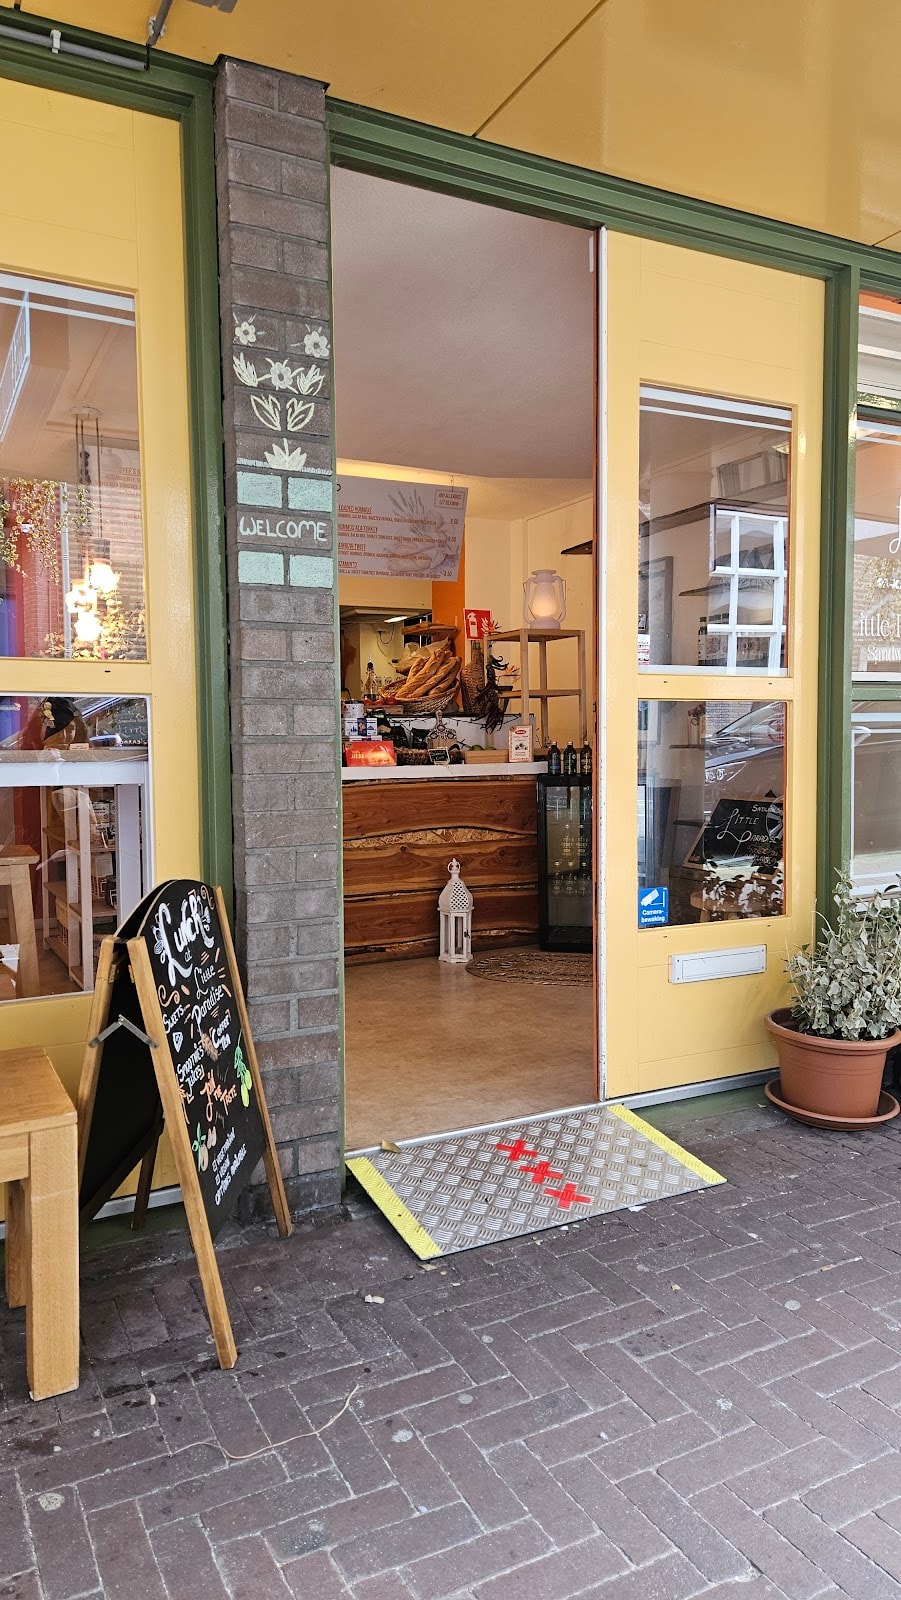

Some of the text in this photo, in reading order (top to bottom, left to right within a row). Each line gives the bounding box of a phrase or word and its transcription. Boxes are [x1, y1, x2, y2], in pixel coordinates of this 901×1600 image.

[239, 516, 328, 541] WELCOME
[857, 613, 890, 637] ittle
[717, 808, 759, 839] LITTLE
[193, 965, 216, 999] Little
[162, 1004, 185, 1034] SWEETS
[191, 985, 224, 1036] Paradise
